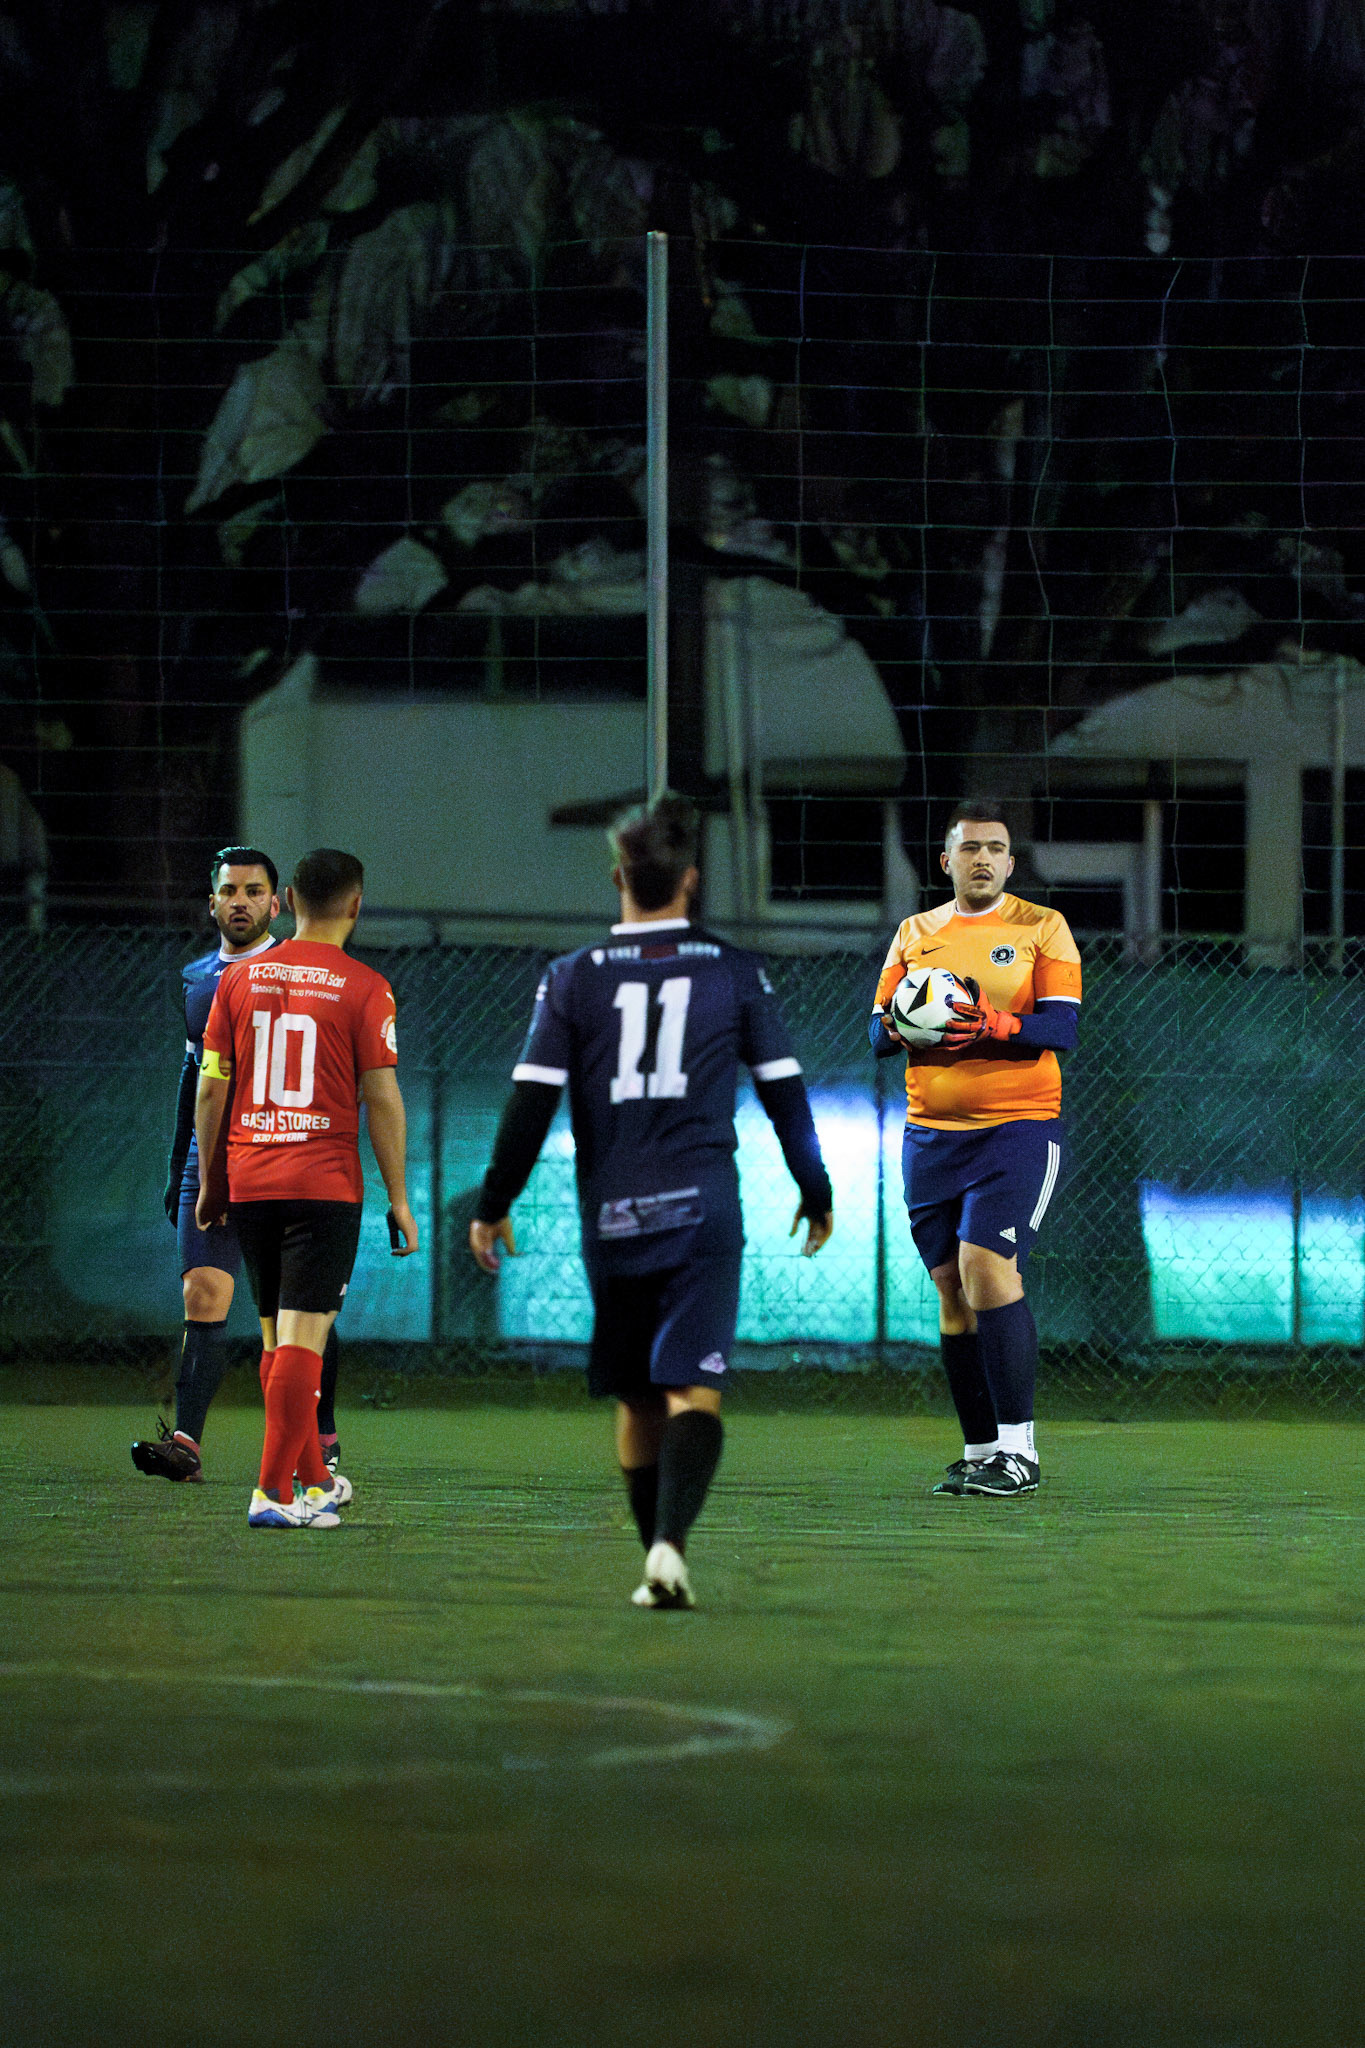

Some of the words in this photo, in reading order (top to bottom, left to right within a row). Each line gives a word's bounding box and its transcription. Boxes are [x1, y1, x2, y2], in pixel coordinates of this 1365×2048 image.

[252, 1009, 317, 1108] 10
[610, 976, 692, 1104] 11
[277, 1110, 330, 1131] STORES
